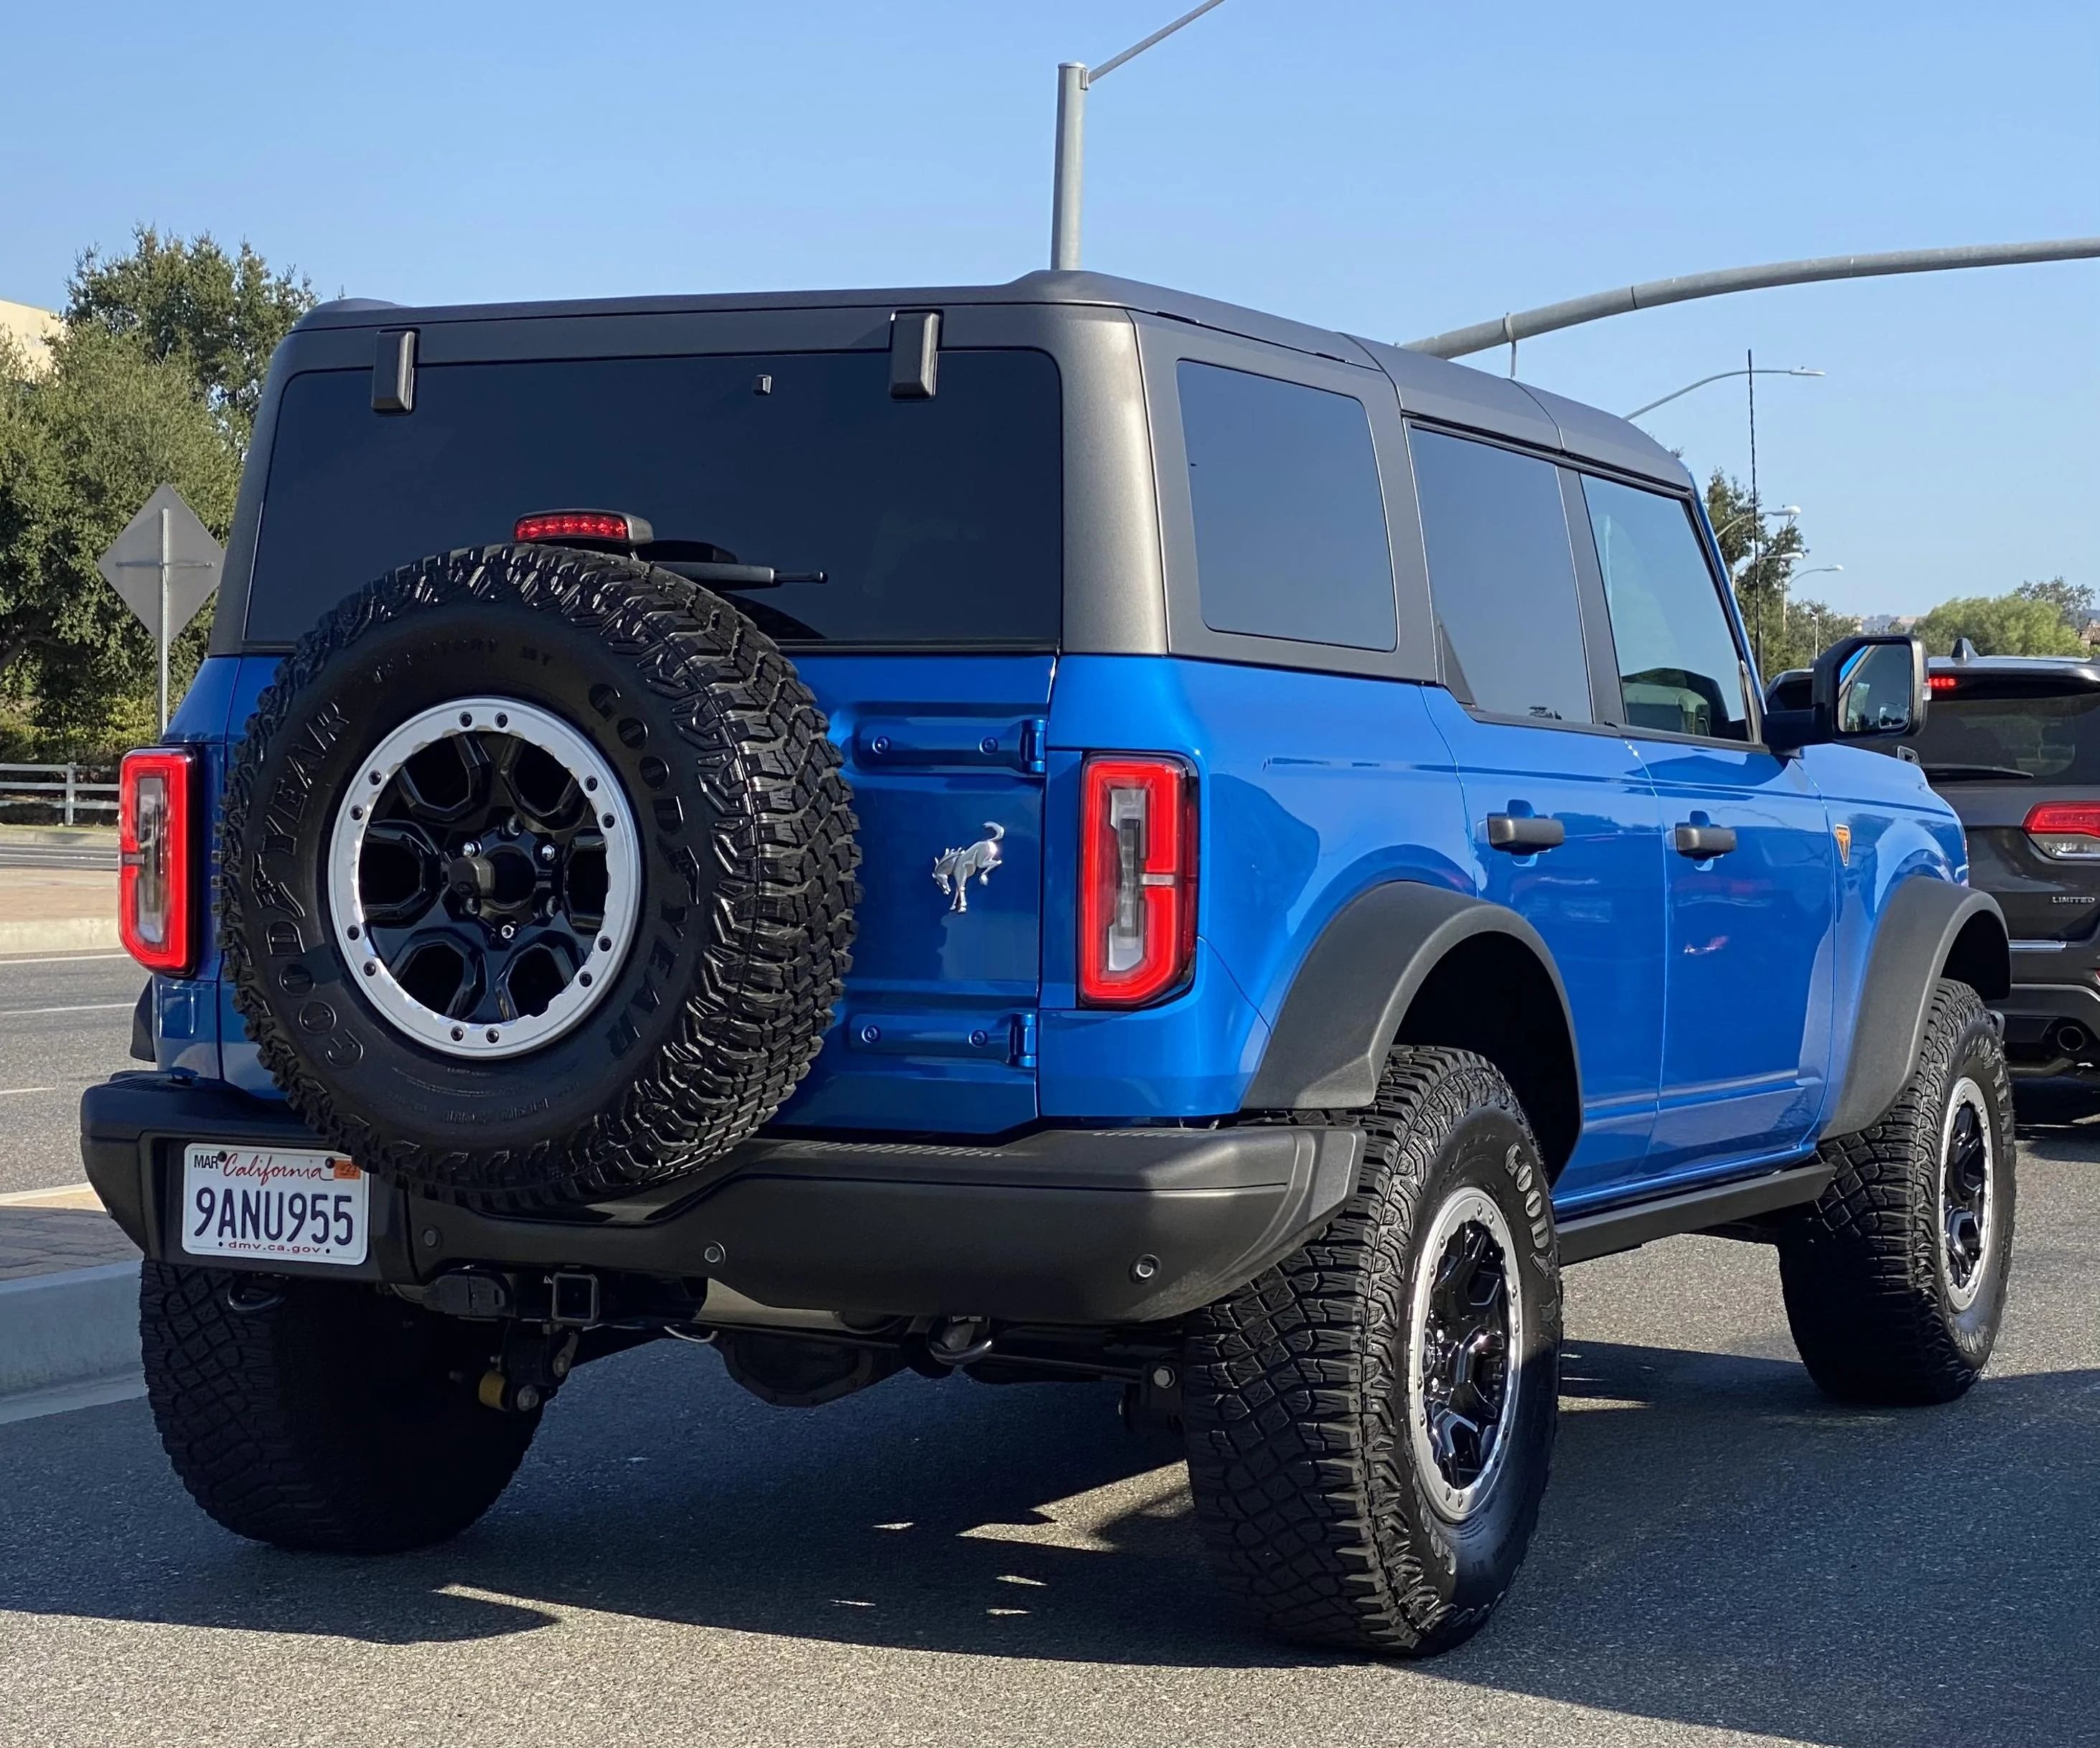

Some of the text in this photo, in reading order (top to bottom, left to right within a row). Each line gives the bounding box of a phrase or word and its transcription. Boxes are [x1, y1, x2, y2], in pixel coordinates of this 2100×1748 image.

[250, 700, 364, 1067] GOODYEAR
[194, 1155, 218, 1169] MAR
[223, 1152, 334, 1185] California
[194, 1187, 353, 1246] 9ANU955
[228, 1241, 322, 1254] dmv.ca.gov
